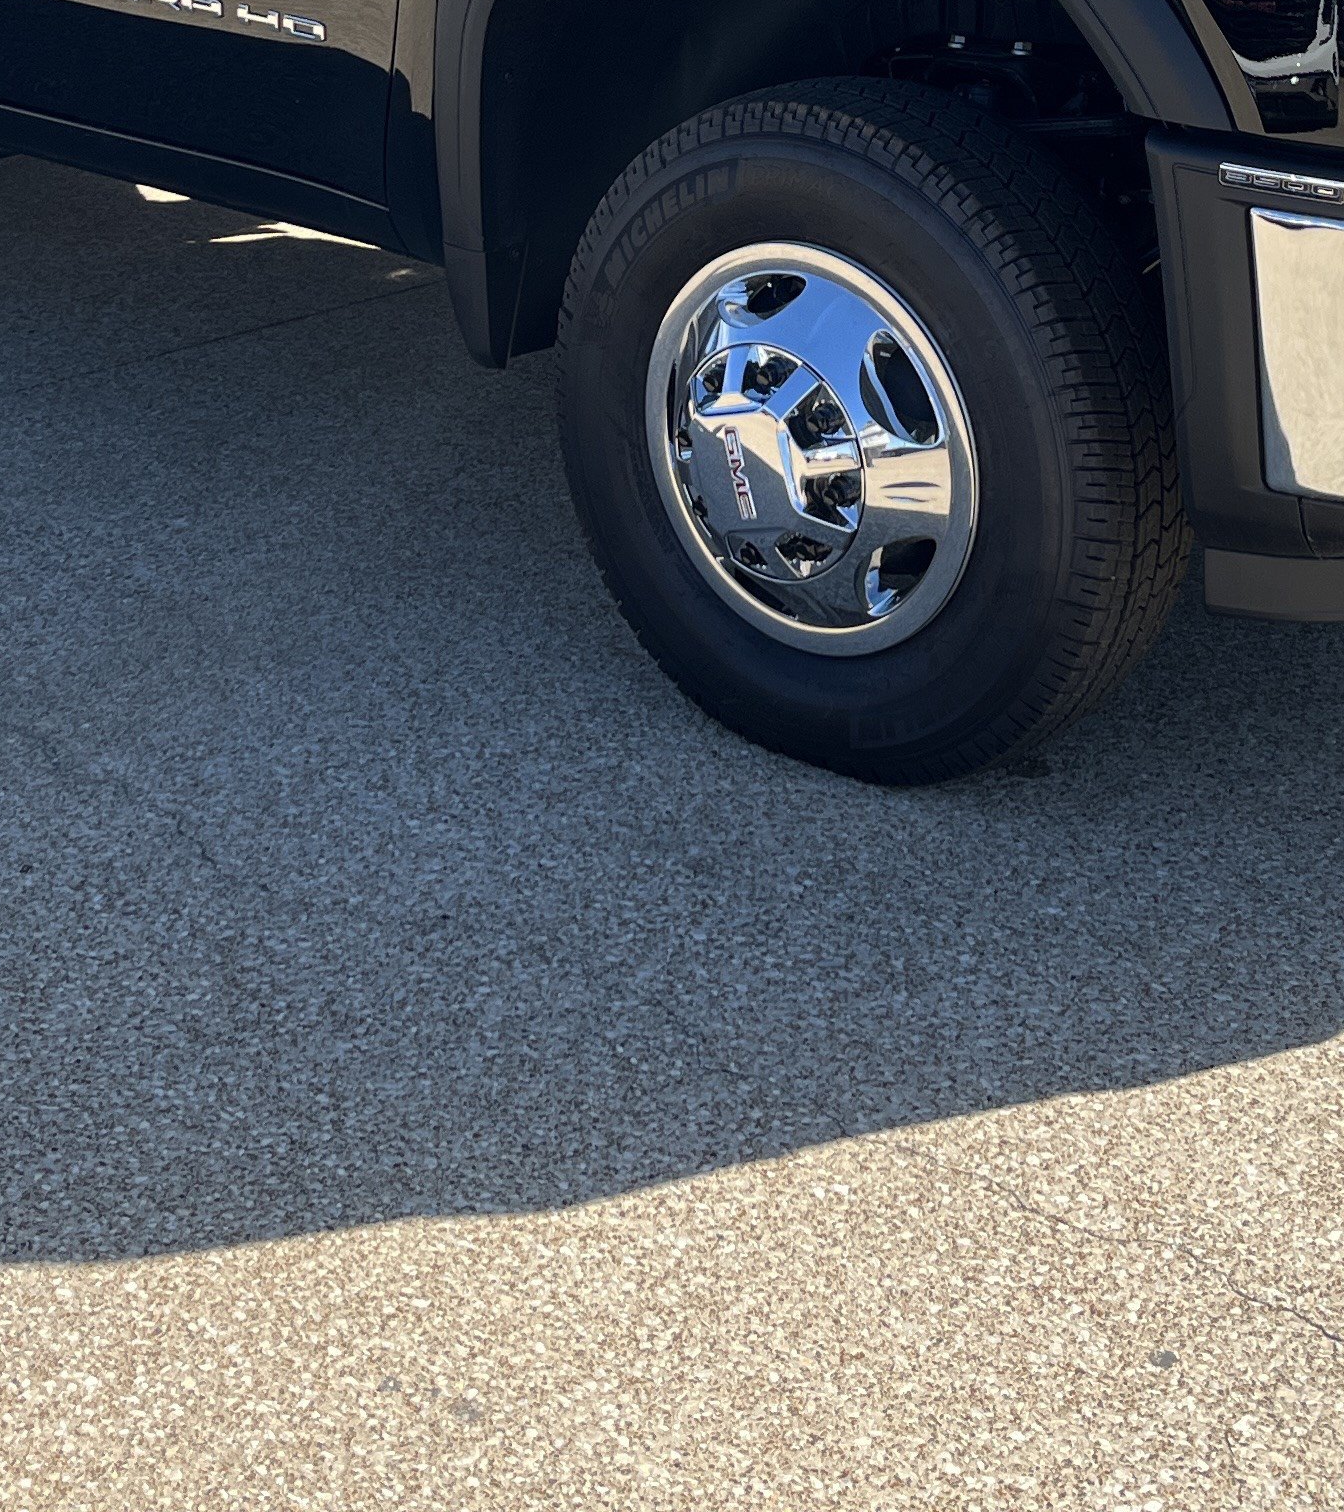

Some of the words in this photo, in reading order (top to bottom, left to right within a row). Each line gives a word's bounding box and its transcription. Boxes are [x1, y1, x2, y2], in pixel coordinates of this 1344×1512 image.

[236, 1, 328, 42] HD
[603, 165, 731, 288] MICHELIN
[723, 426, 758, 521] GMC
